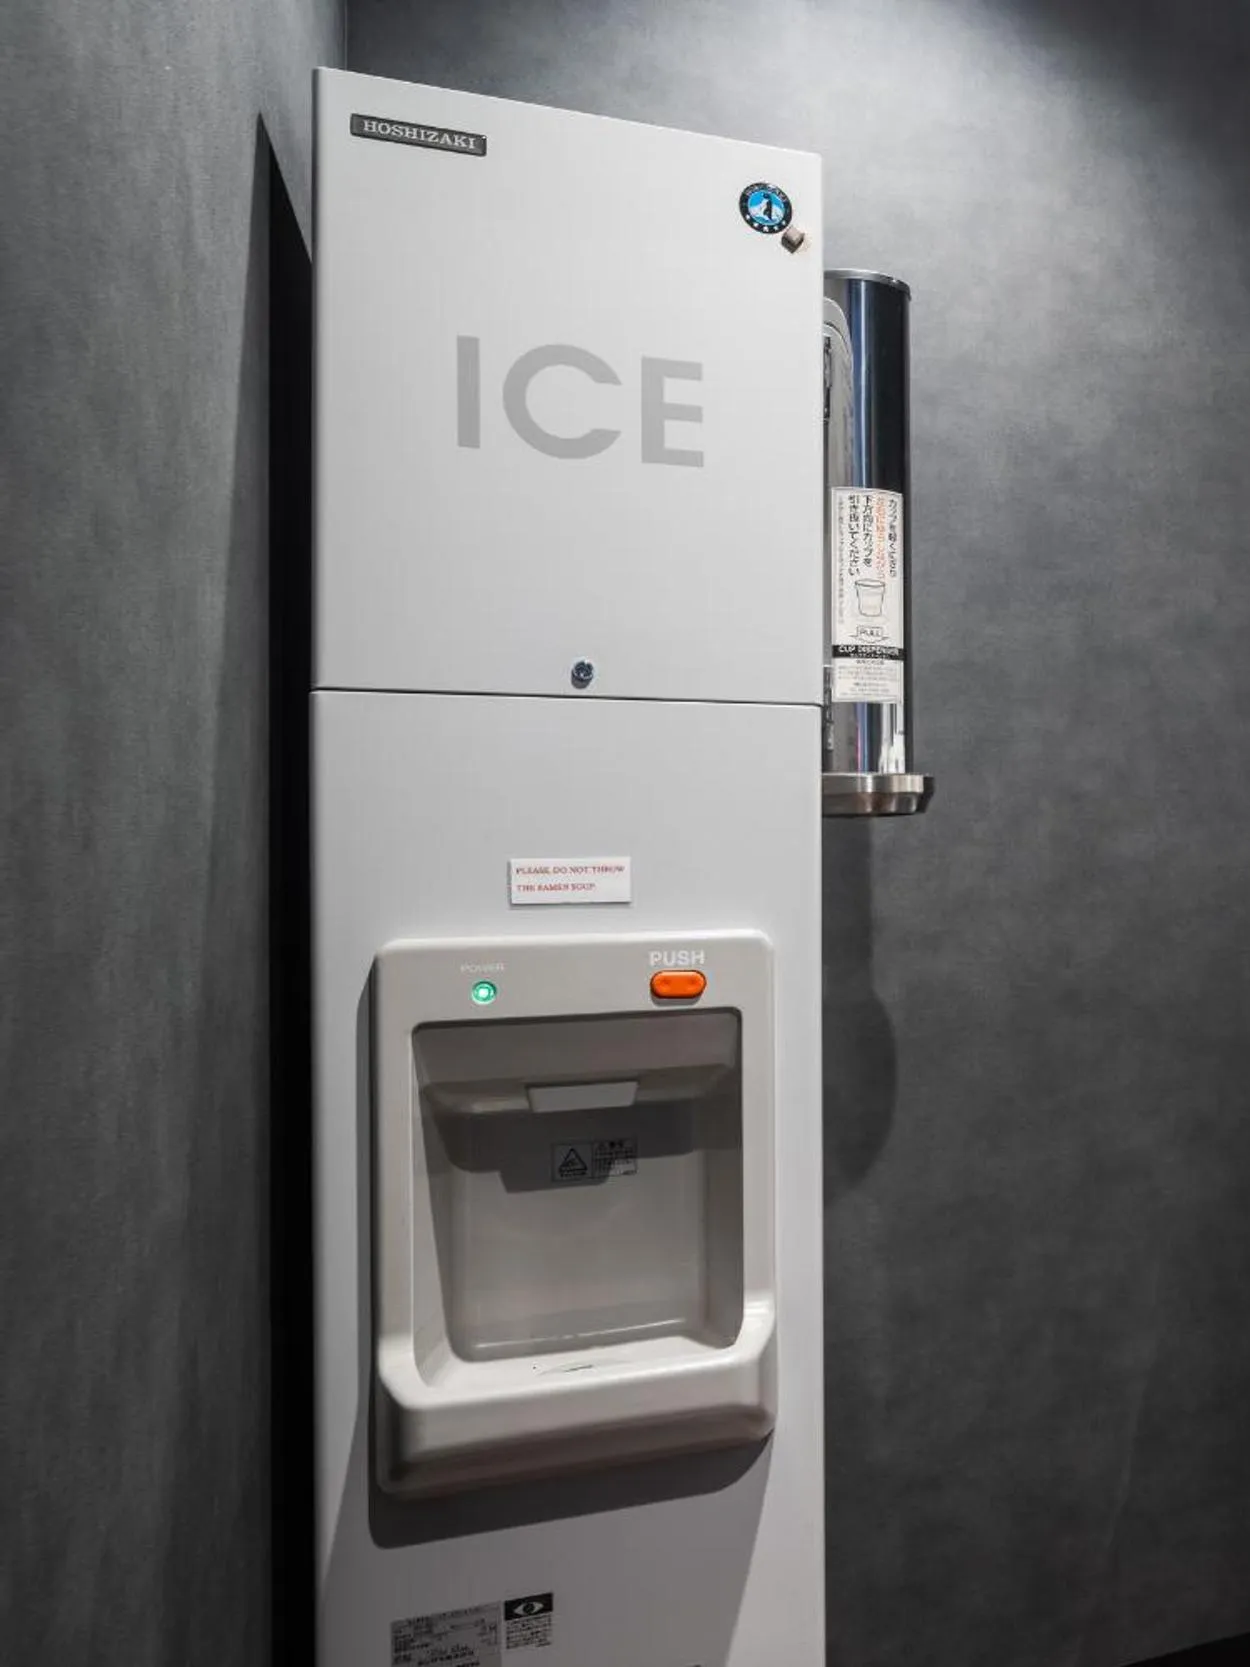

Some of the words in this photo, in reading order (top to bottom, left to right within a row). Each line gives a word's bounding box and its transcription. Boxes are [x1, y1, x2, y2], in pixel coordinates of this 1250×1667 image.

[363, 119, 477, 149] HOSHIZAKI
[456, 335, 704, 467] ICE
[515, 865, 550, 875] PLEASE
[552, 865, 568, 874] DO
[569, 865, 589, 873] NOT
[591, 864, 625, 873] THROW
[516, 884, 536, 892] THE
[649, 951, 706, 966] PUSH
